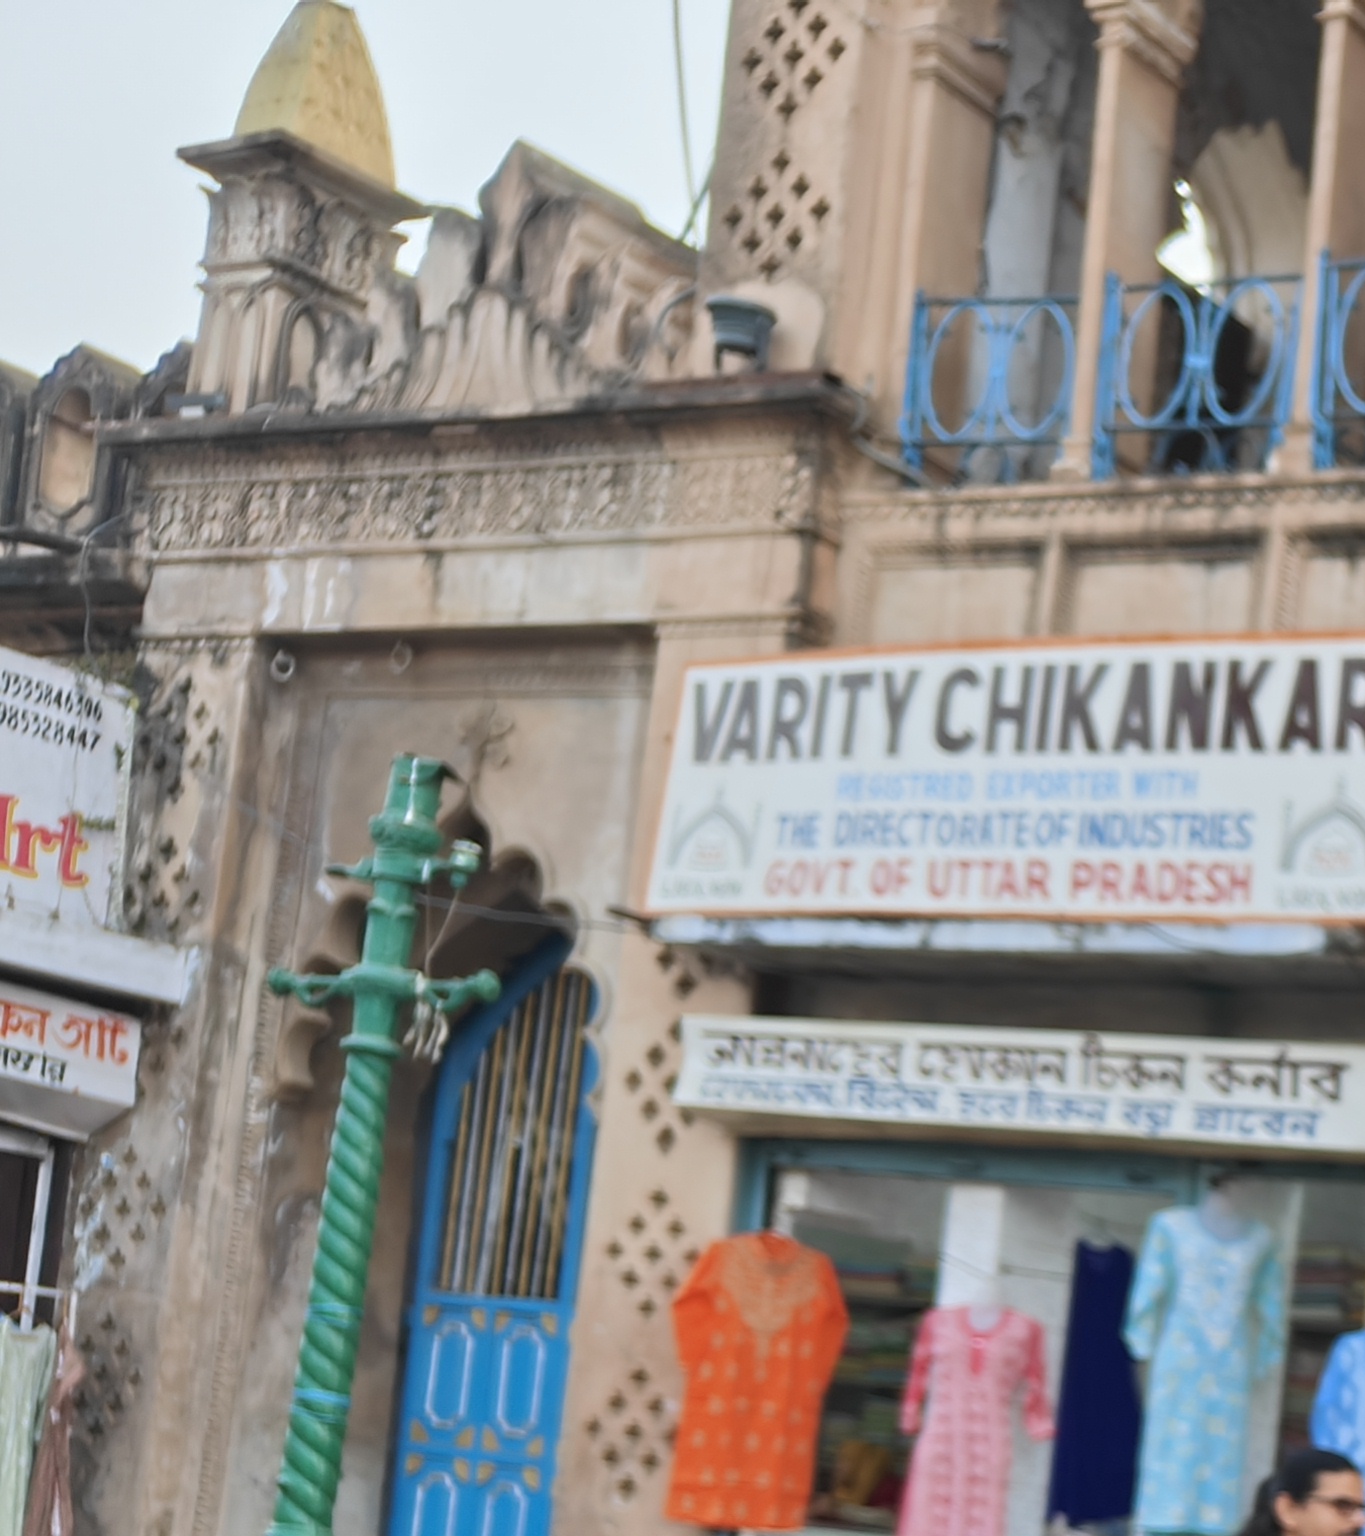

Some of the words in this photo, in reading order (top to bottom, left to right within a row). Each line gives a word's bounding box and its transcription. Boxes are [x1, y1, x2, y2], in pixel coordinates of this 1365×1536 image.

[692, 667, 922, 763] VARITY
[987, 770, 1121, 800] EXPORTER
[1133, 770, 1198, 798] WITH
[777, 811, 821, 848] THE
[834, 810, 1030, 851] DIRECTORATE
[1035, 812, 1074, 848] OF
[1078, 811, 1255, 850] INDUSTRIES
[868, 856, 912, 898] OF
[926, 857, 1051, 902] UTTAR
[1068, 857, 1254, 905] PRADESH
